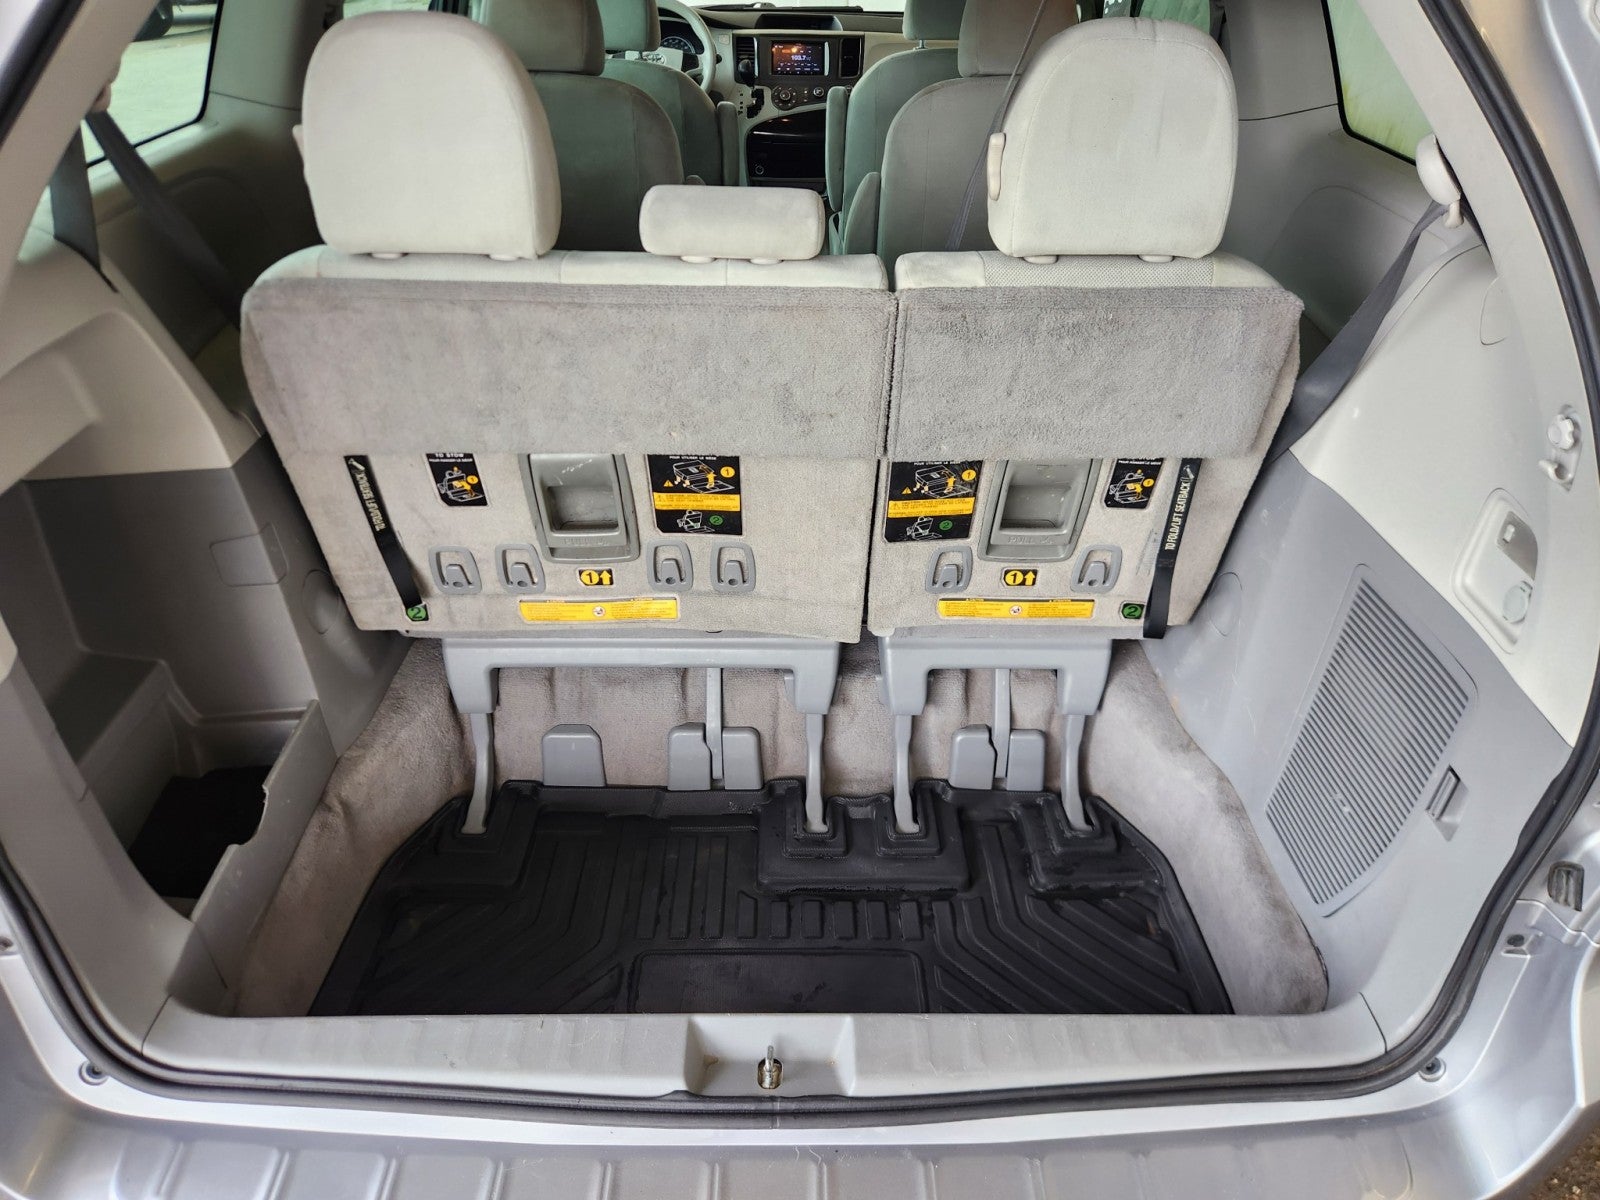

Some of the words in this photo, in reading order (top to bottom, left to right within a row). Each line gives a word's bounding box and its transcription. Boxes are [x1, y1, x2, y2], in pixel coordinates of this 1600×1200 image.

[1174, 483, 1191, 513] SEATBACK
[1167, 513, 1183, 543] FOLD/LIFT
[410, 606, 423, 619] 2
[1127, 606, 1139, 617] 2
